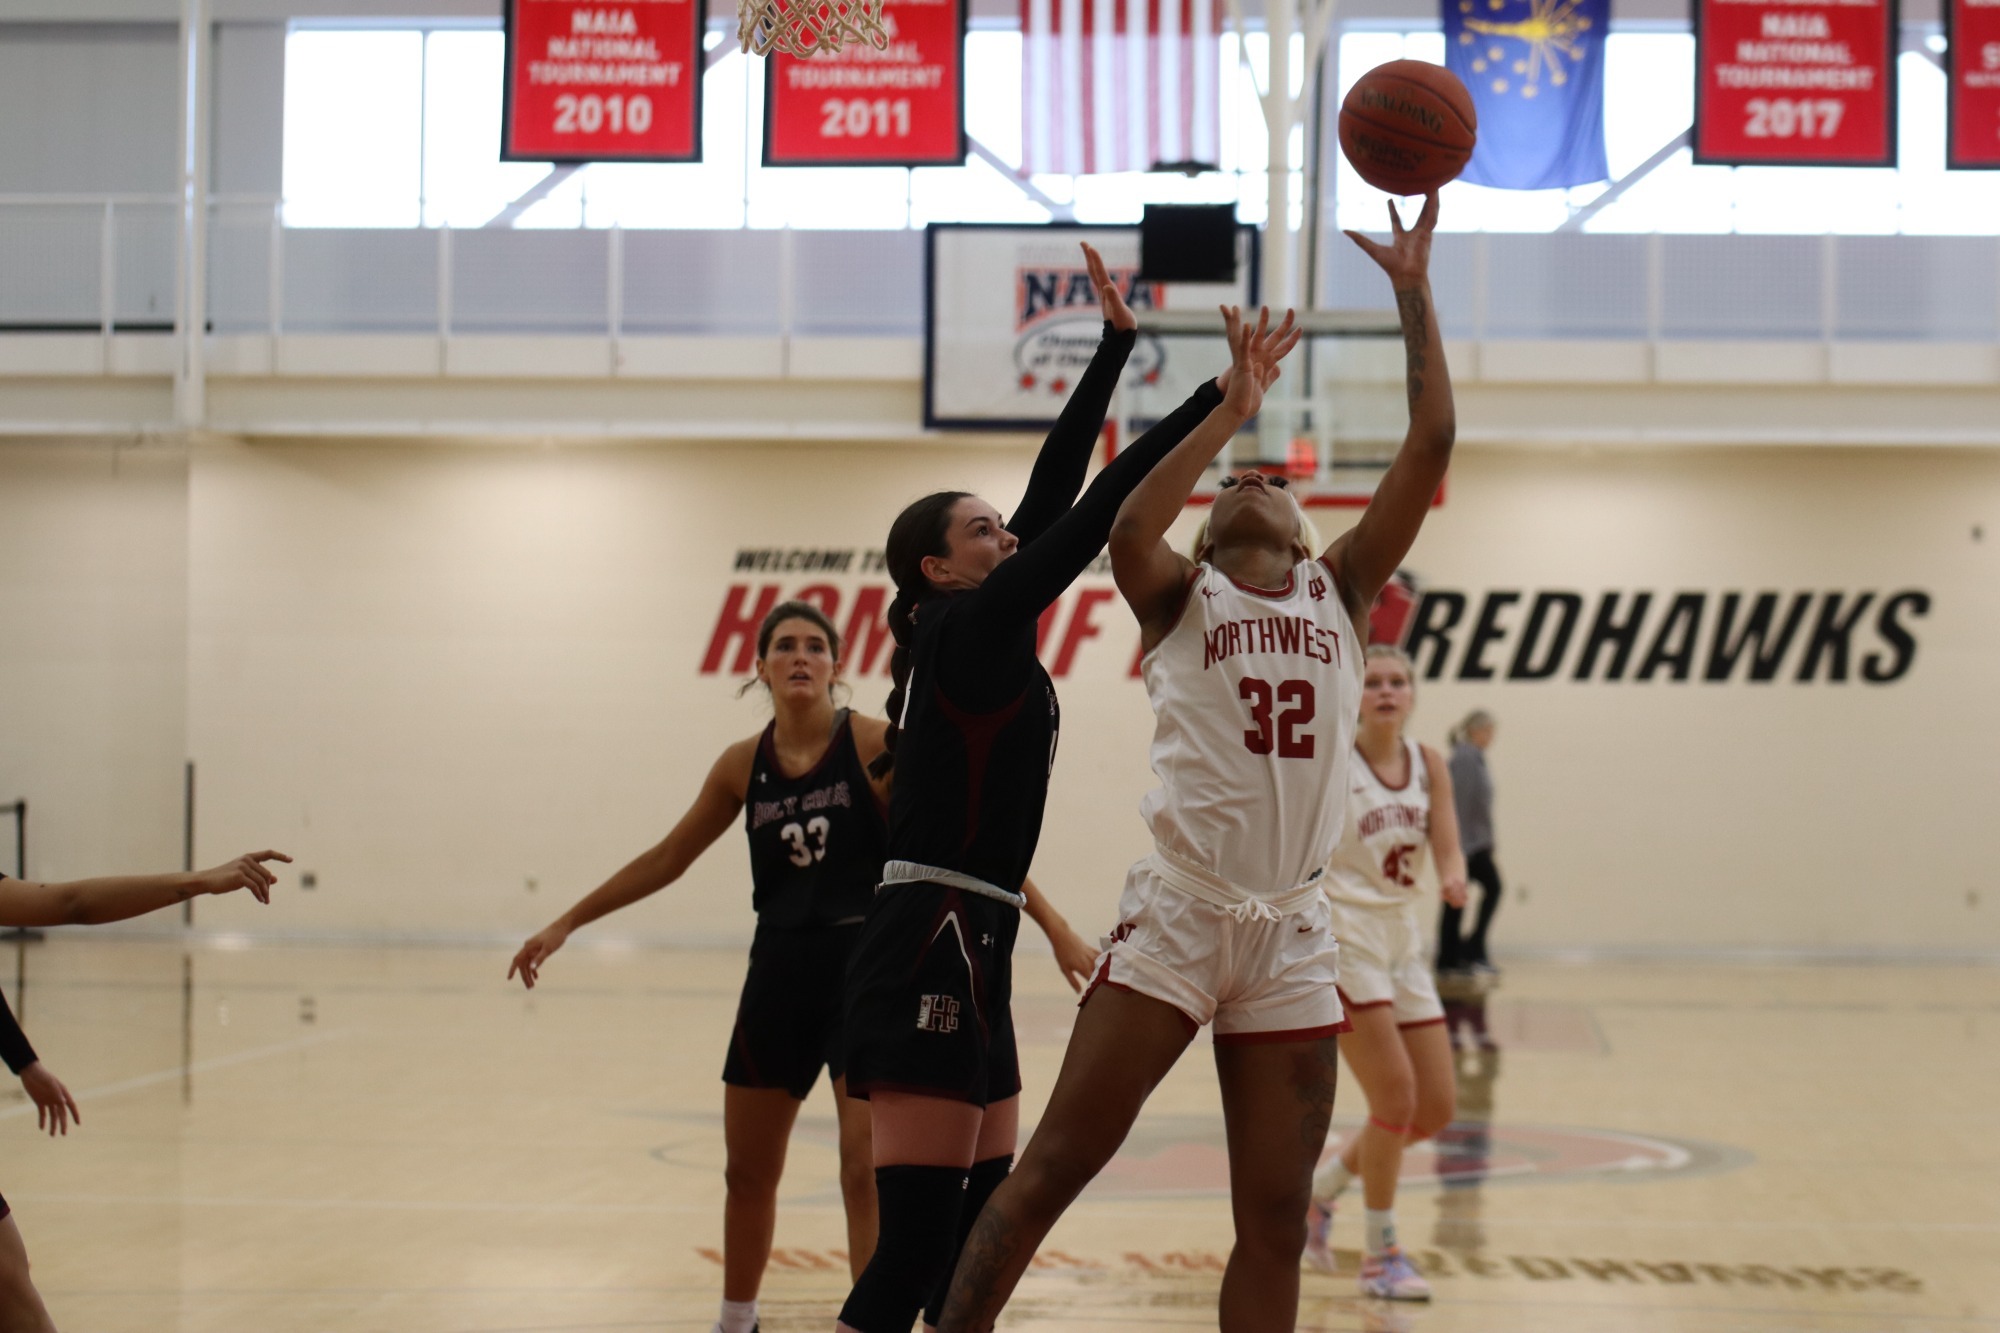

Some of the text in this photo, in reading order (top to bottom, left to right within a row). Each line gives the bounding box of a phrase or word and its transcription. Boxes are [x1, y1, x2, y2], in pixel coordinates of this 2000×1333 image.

[570, 8, 638, 35] NAIA
[1760, 13, 1832, 39] NAIA
[546, 35, 661, 61] NATIONAL
[1734, 40, 1855, 64] NATIONAL
[527, 60, 683, 87] TOURNAMENT
[786, 64, 945, 89] TOURNAMENT
[1713, 63, 1875, 90] TOURNAMENT
[552, 94, 654, 134] 2010
[819, 98, 912, 138] 2011
[1743, 97, 1846, 138] 2017
[1022, 273, 1154, 322] NAA
[733, 549, 856, 574] WELCOME
[1036, 584, 1117, 680] F
[1203, 616, 1341, 671] NORTHWEST
[1402, 588, 1935, 684] REDHAWKS
[1238, 676, 1316, 760] 32
[781, 815, 830, 868] 33
